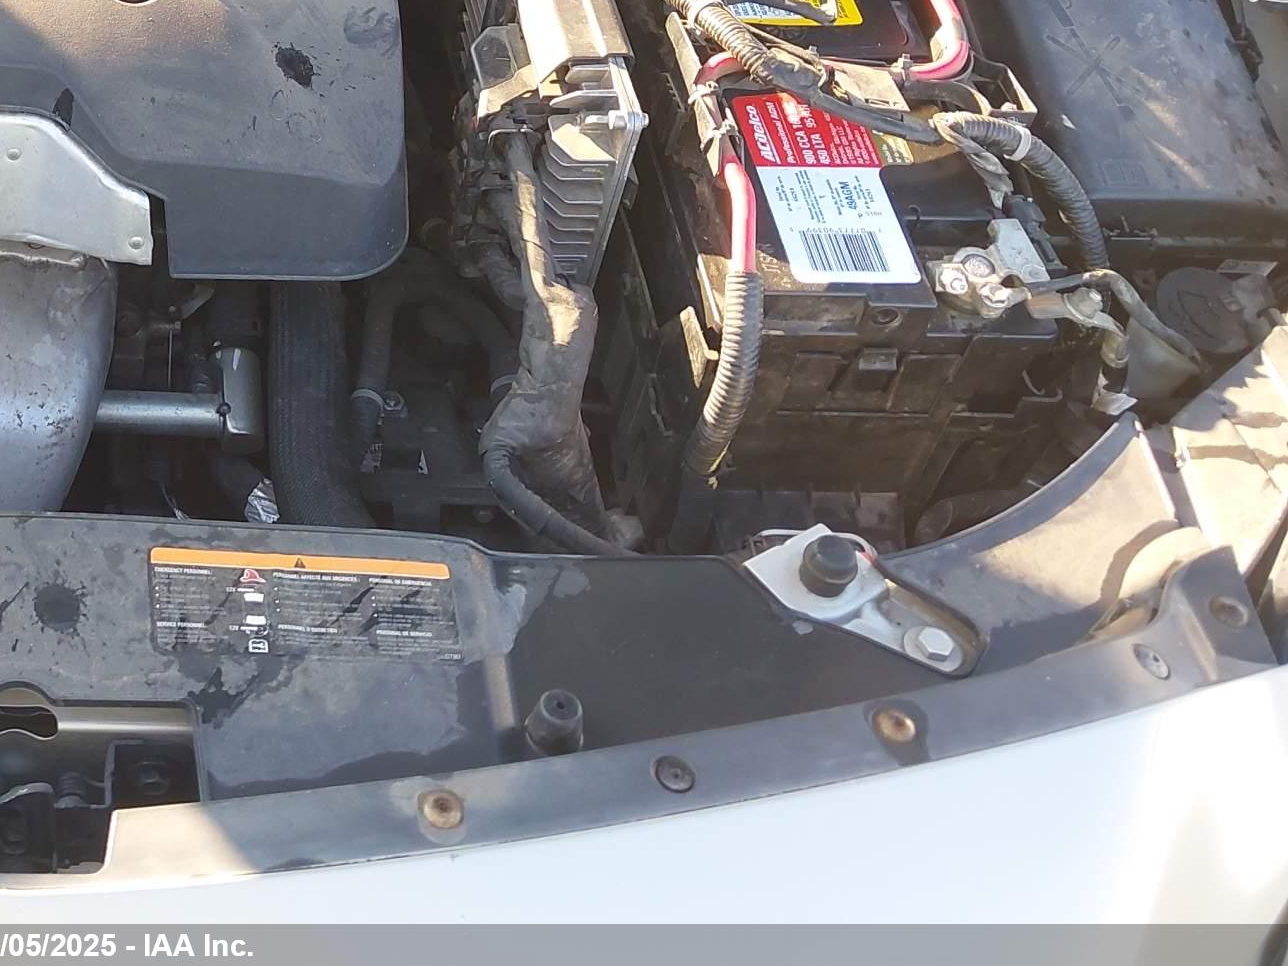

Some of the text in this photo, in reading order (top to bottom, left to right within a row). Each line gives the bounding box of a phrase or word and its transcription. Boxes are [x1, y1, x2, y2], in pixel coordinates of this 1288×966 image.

[745, 105, 776, 163] ACDelco
[771, 120, 797, 164] Professional
[794, 130, 812, 148] CCA
[809, 132, 825, 149] LTA
[802, 149, 817, 165] 900
[838, 181, 858, 210] 49AGM
